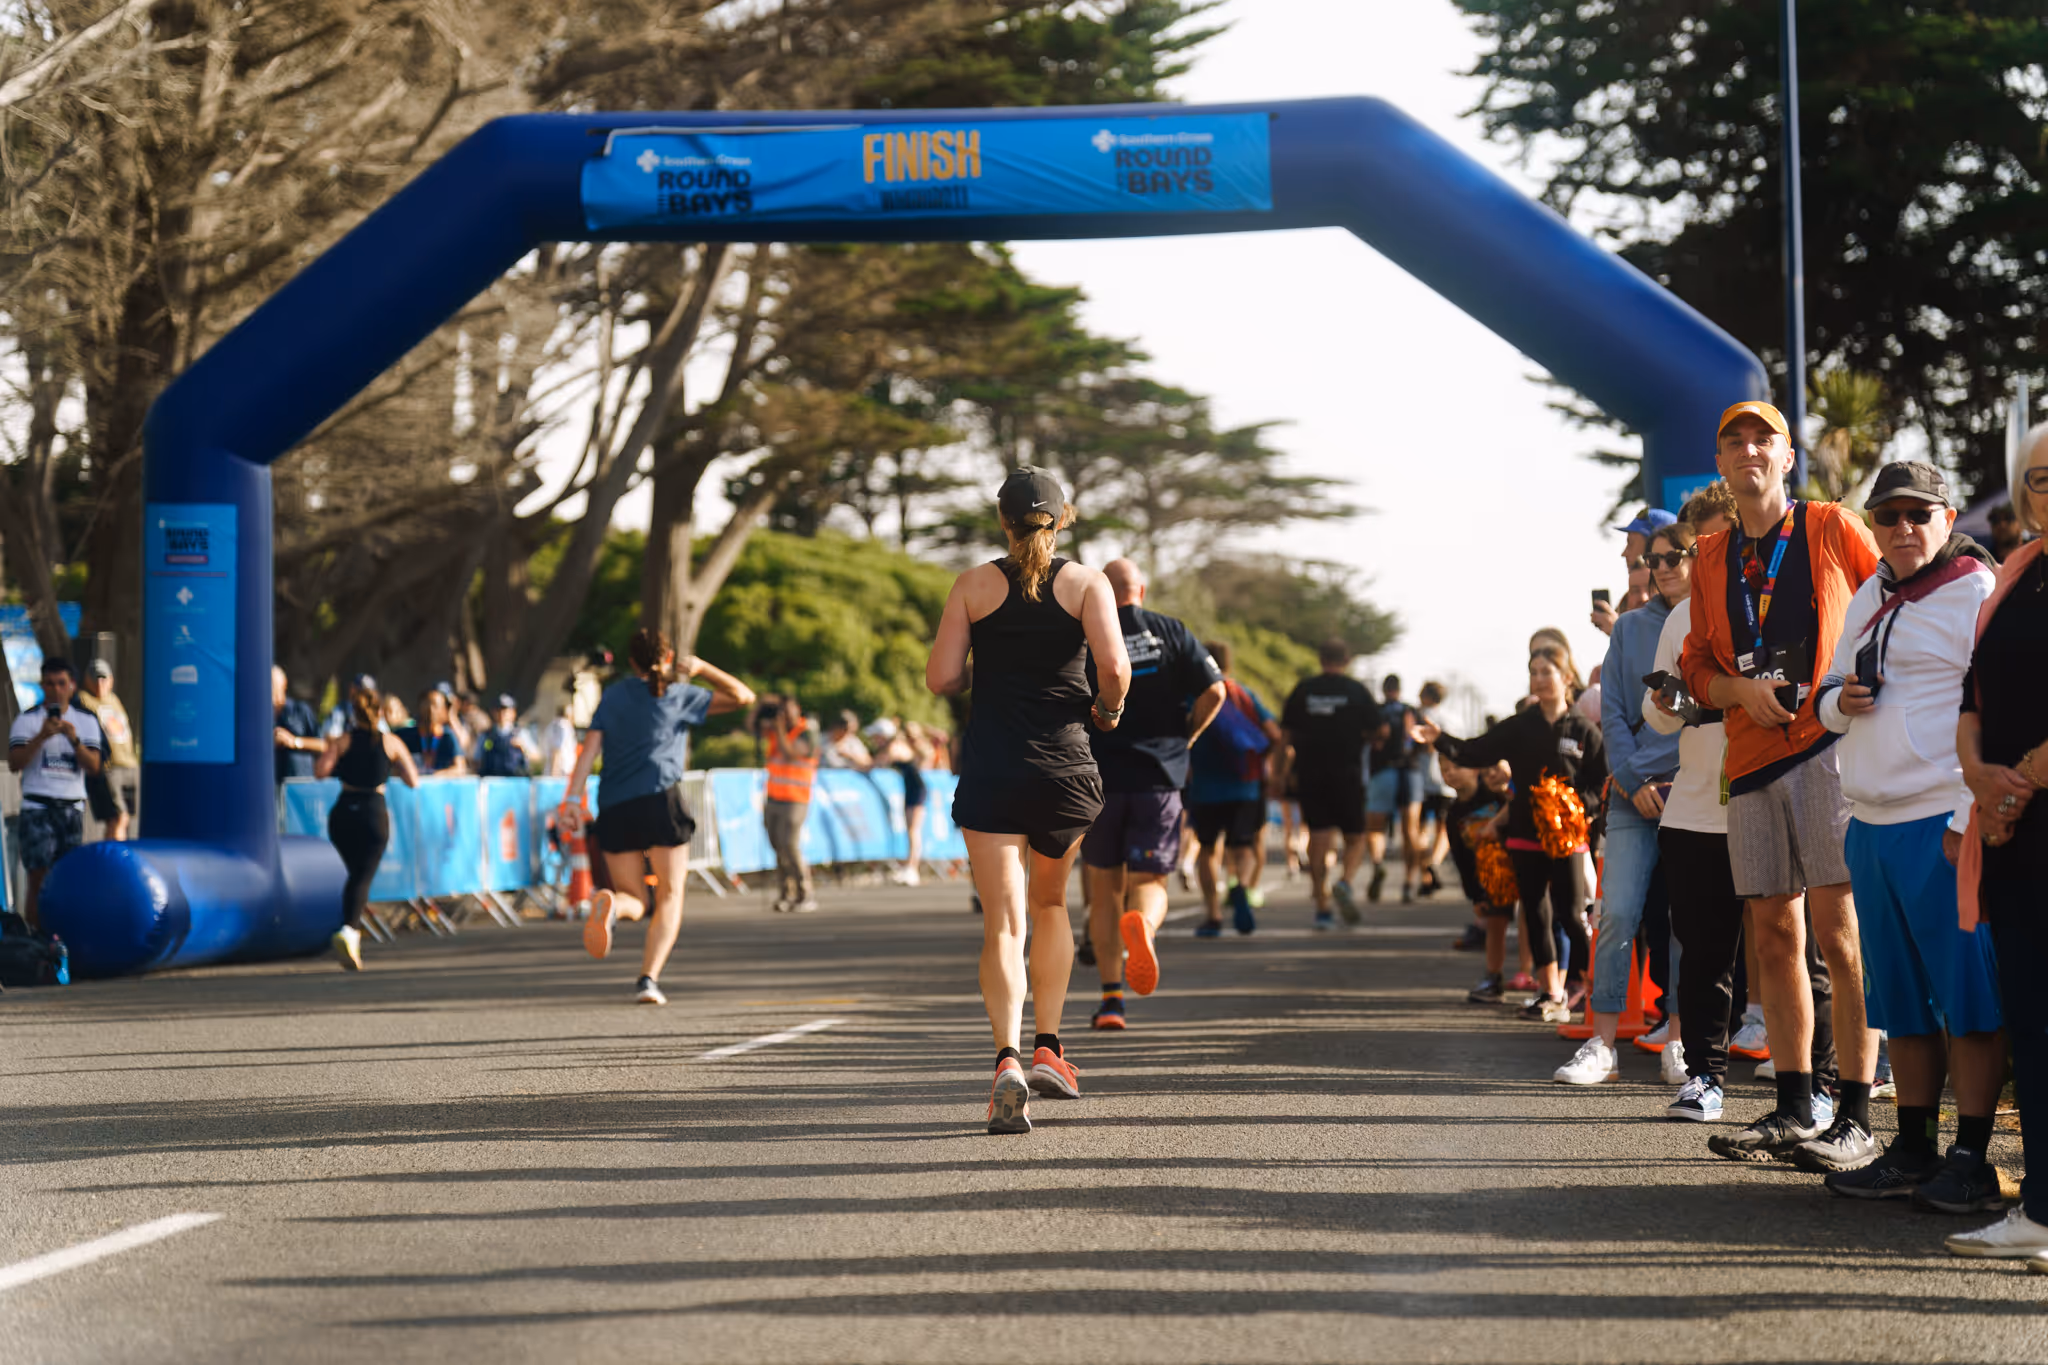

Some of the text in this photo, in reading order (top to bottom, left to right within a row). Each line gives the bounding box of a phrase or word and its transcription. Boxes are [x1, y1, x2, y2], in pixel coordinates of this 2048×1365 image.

[863, 129, 981, 184] FINISH
[1115, 146, 1213, 169] ROUND
[657, 168, 753, 190] ROUND
[1128, 168, 1215, 194] BAYS
[668, 190, 755, 216] BAYS
